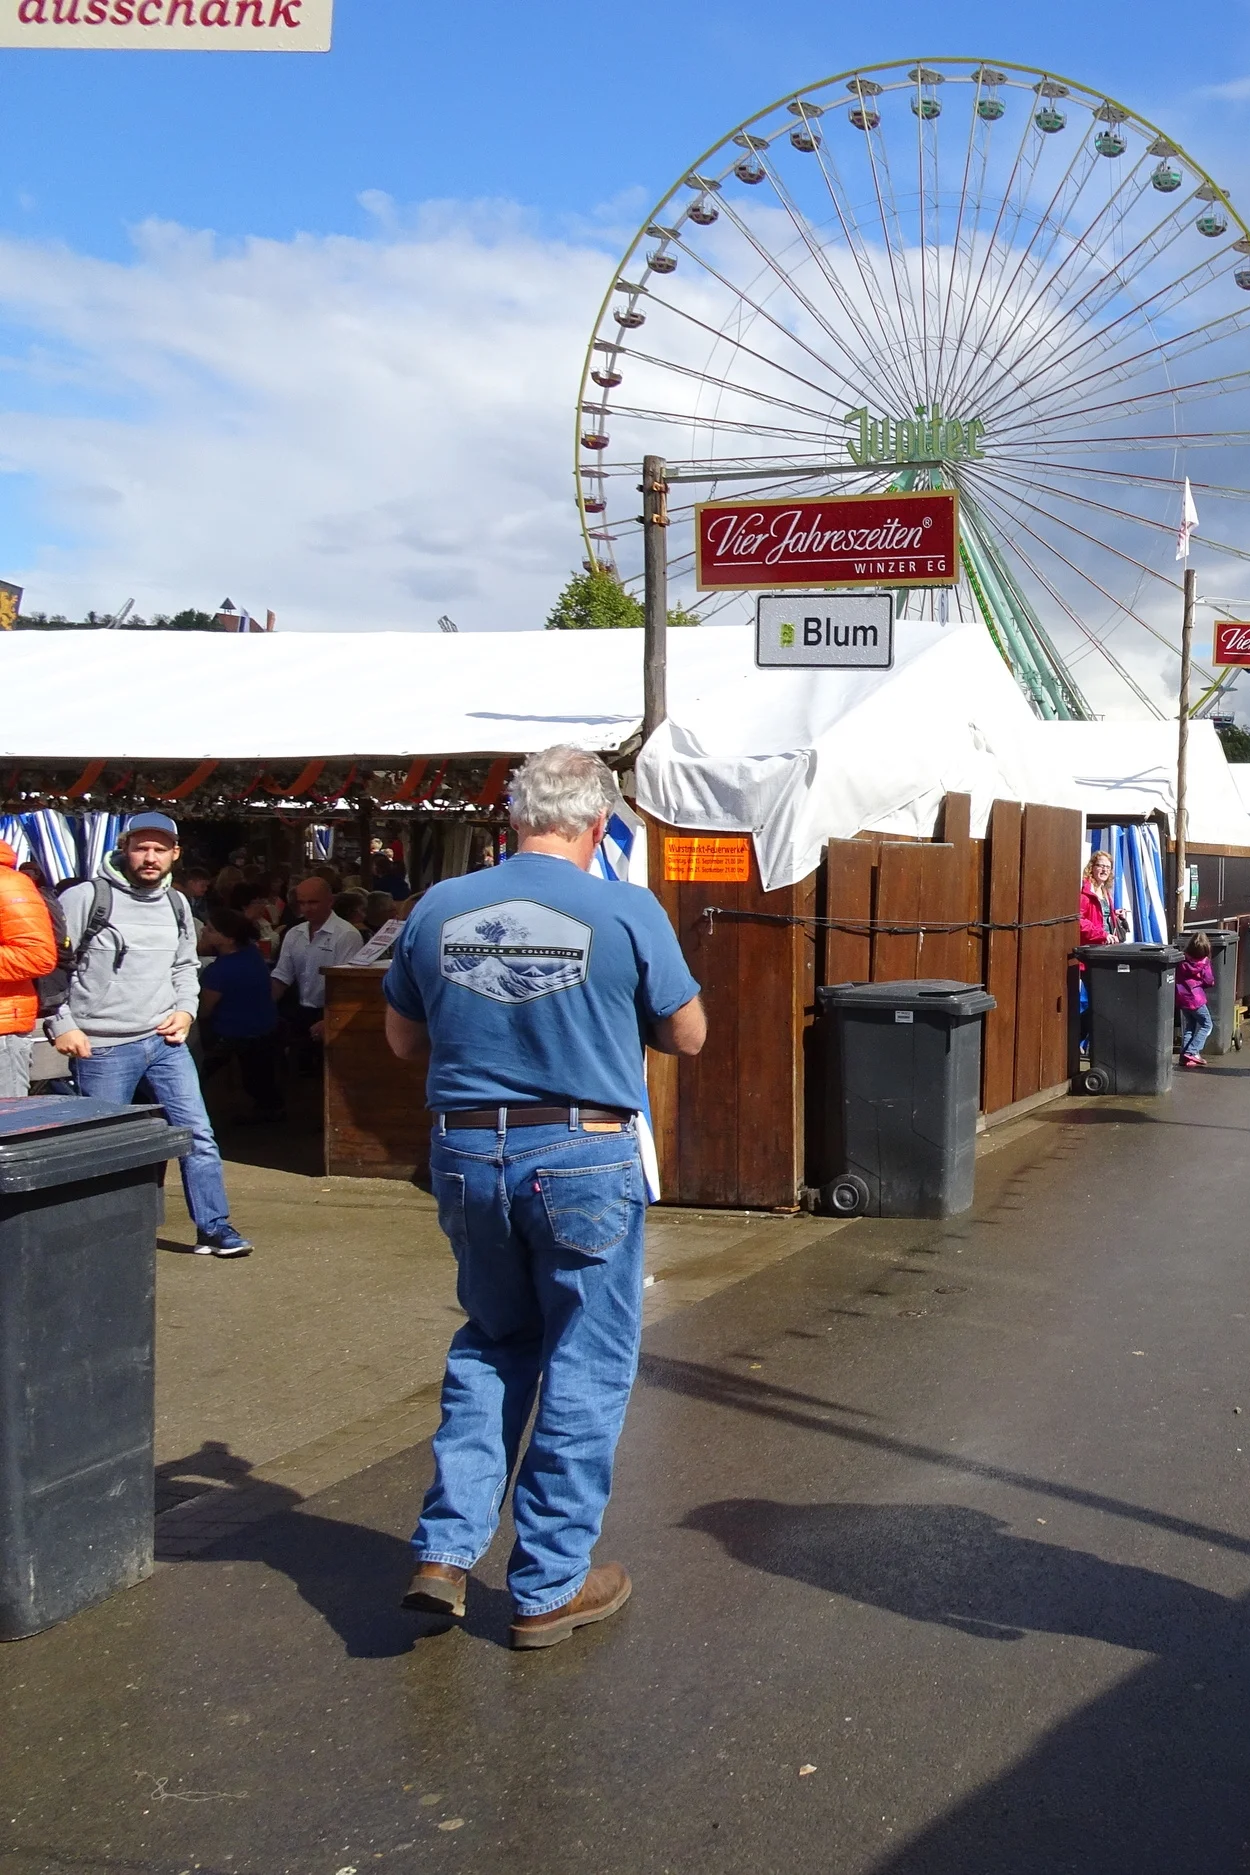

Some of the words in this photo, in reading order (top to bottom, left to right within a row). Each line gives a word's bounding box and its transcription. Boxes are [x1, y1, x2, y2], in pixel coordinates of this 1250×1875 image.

[844, 402, 986, 465] Jupiter
[707, 513, 770, 557] Vier
[854, 561, 917, 574] WINZER
[926, 560, 946, 572] EG
[803, 617, 878, 647] Blum
[521, 949, 578, 957] COLLECTION
